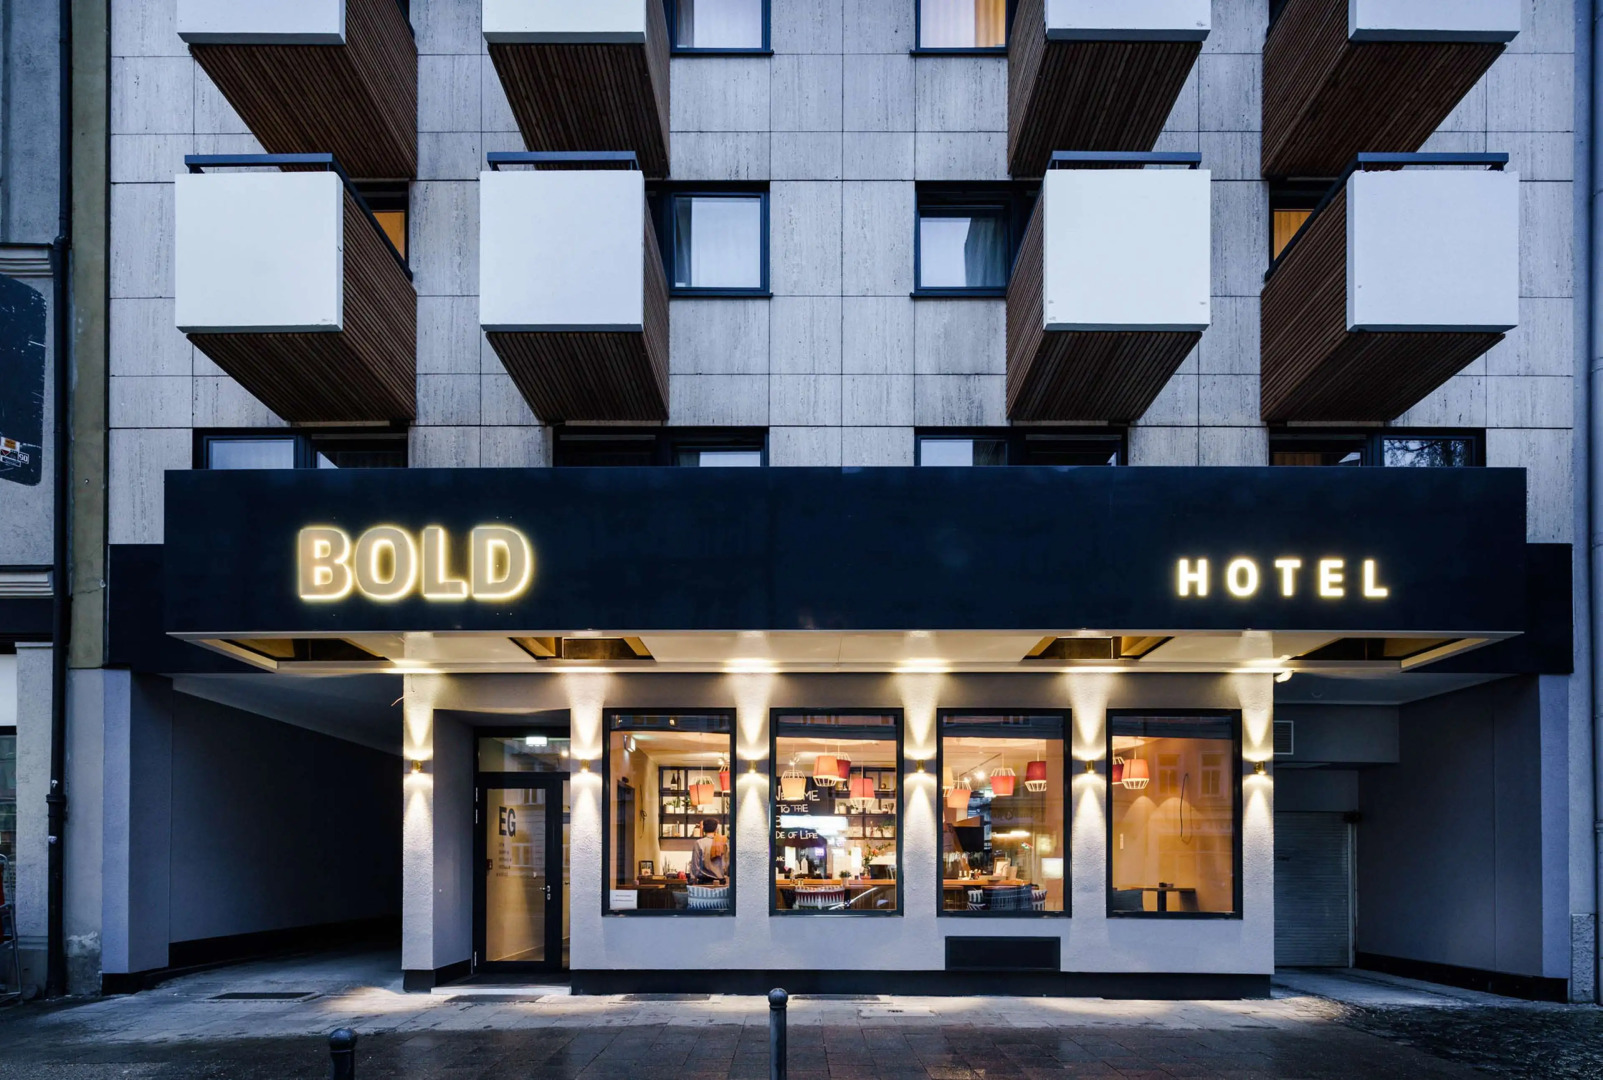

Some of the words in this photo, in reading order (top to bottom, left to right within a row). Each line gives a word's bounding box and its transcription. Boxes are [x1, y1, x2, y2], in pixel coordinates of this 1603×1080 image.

[298, 525, 534, 601] BOLD
[1177, 558, 1389, 597] HOTEL
[791, 804, 809, 813] THE
[499, 806, 516, 837] EG
[776, 831, 786, 839] DE
